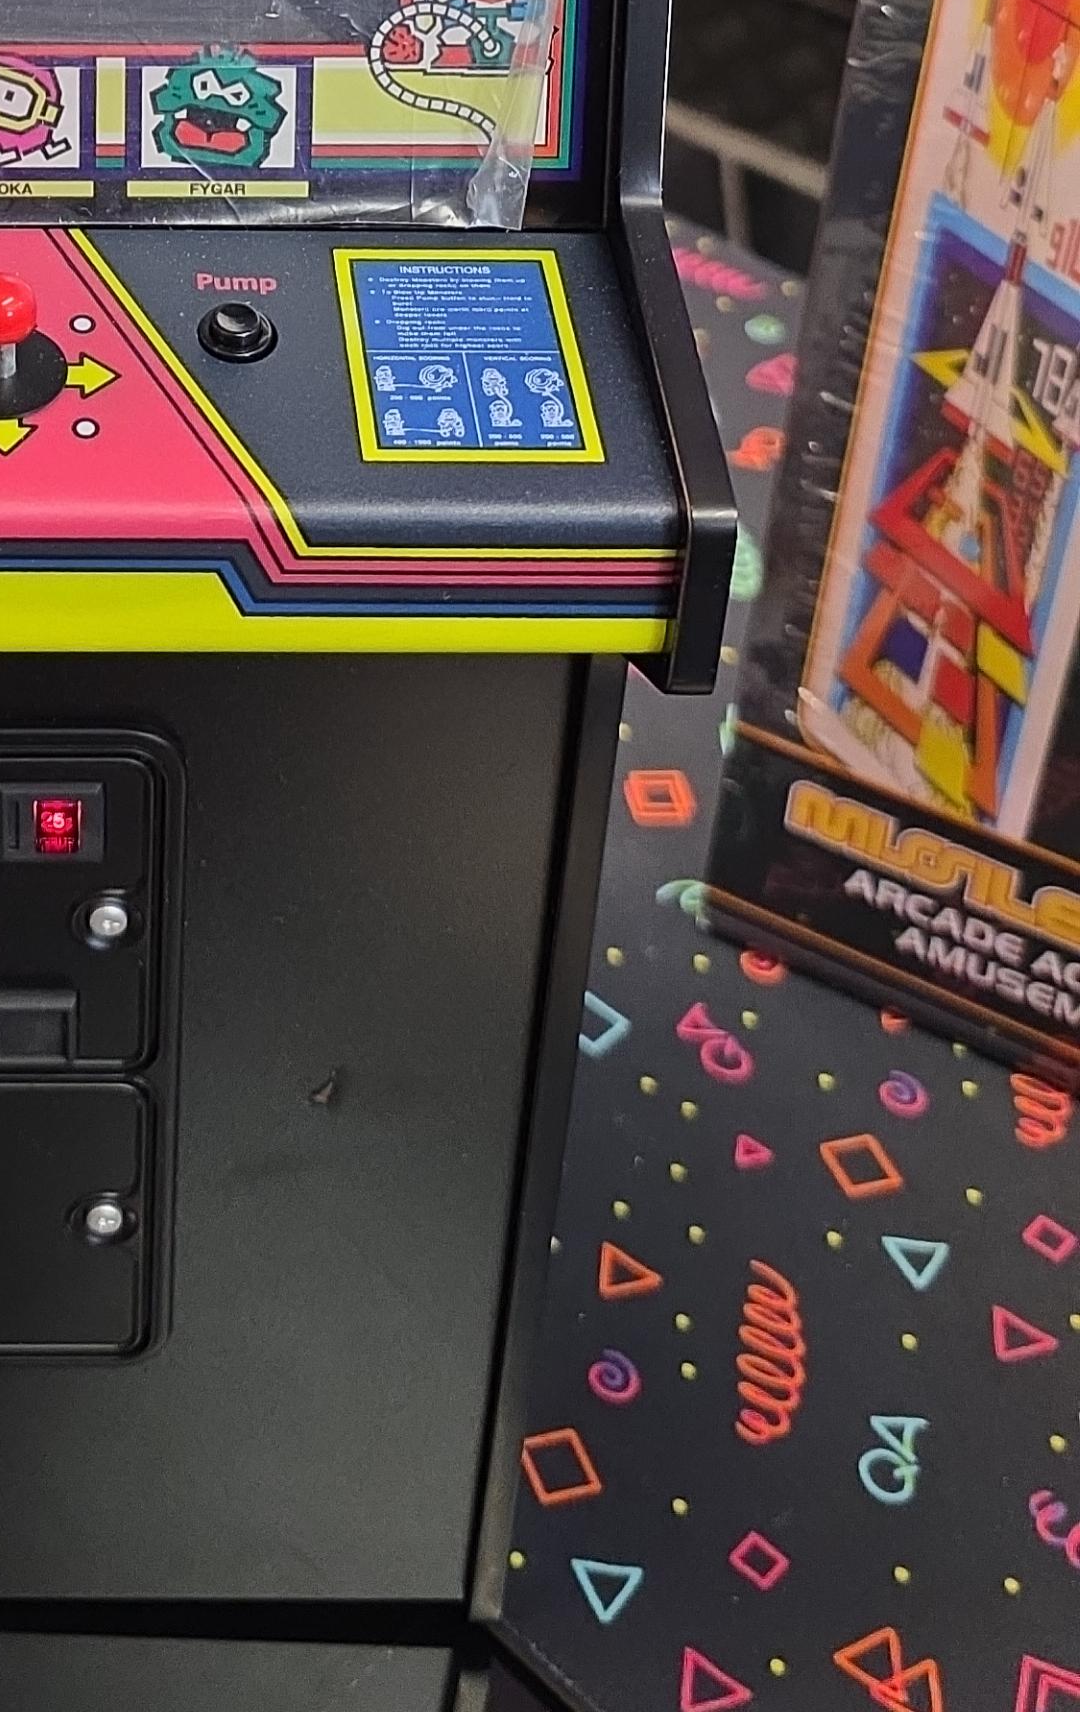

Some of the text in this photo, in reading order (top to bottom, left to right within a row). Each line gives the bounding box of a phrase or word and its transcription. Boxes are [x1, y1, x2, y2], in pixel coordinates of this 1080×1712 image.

[188, 182, 247, 196] FYGAR
[399, 265, 491, 274] INSTRUCTIONS
[196, 272, 278, 295] Pump
[844, 869, 1026, 965] ARCADE
